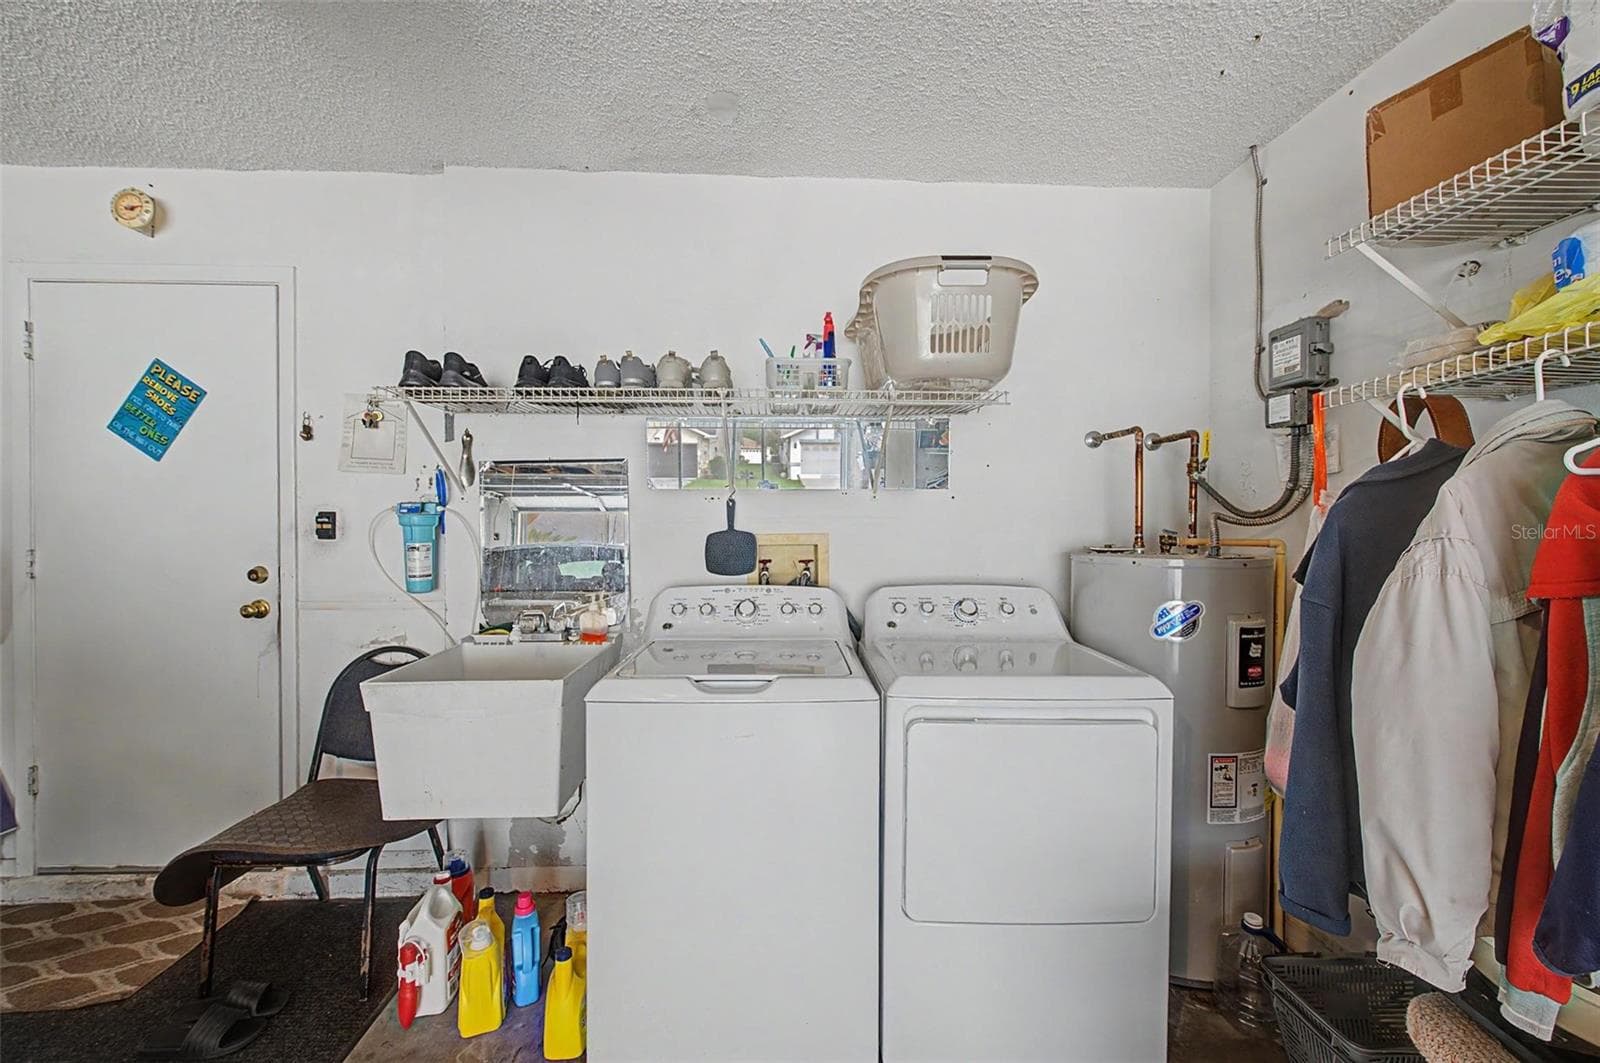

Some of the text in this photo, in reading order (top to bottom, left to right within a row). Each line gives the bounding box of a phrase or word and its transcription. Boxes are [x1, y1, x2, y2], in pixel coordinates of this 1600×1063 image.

[1570, 82, 1580, 99] 9
[142, 375, 178, 403] REMOVE
[150, 364, 200, 403] PLEASE
[124, 402, 157, 427] BETTER
[144, 389, 176, 416] SHOES
[139, 425, 168, 445] ONES
[147, 444, 162, 456] OUT
